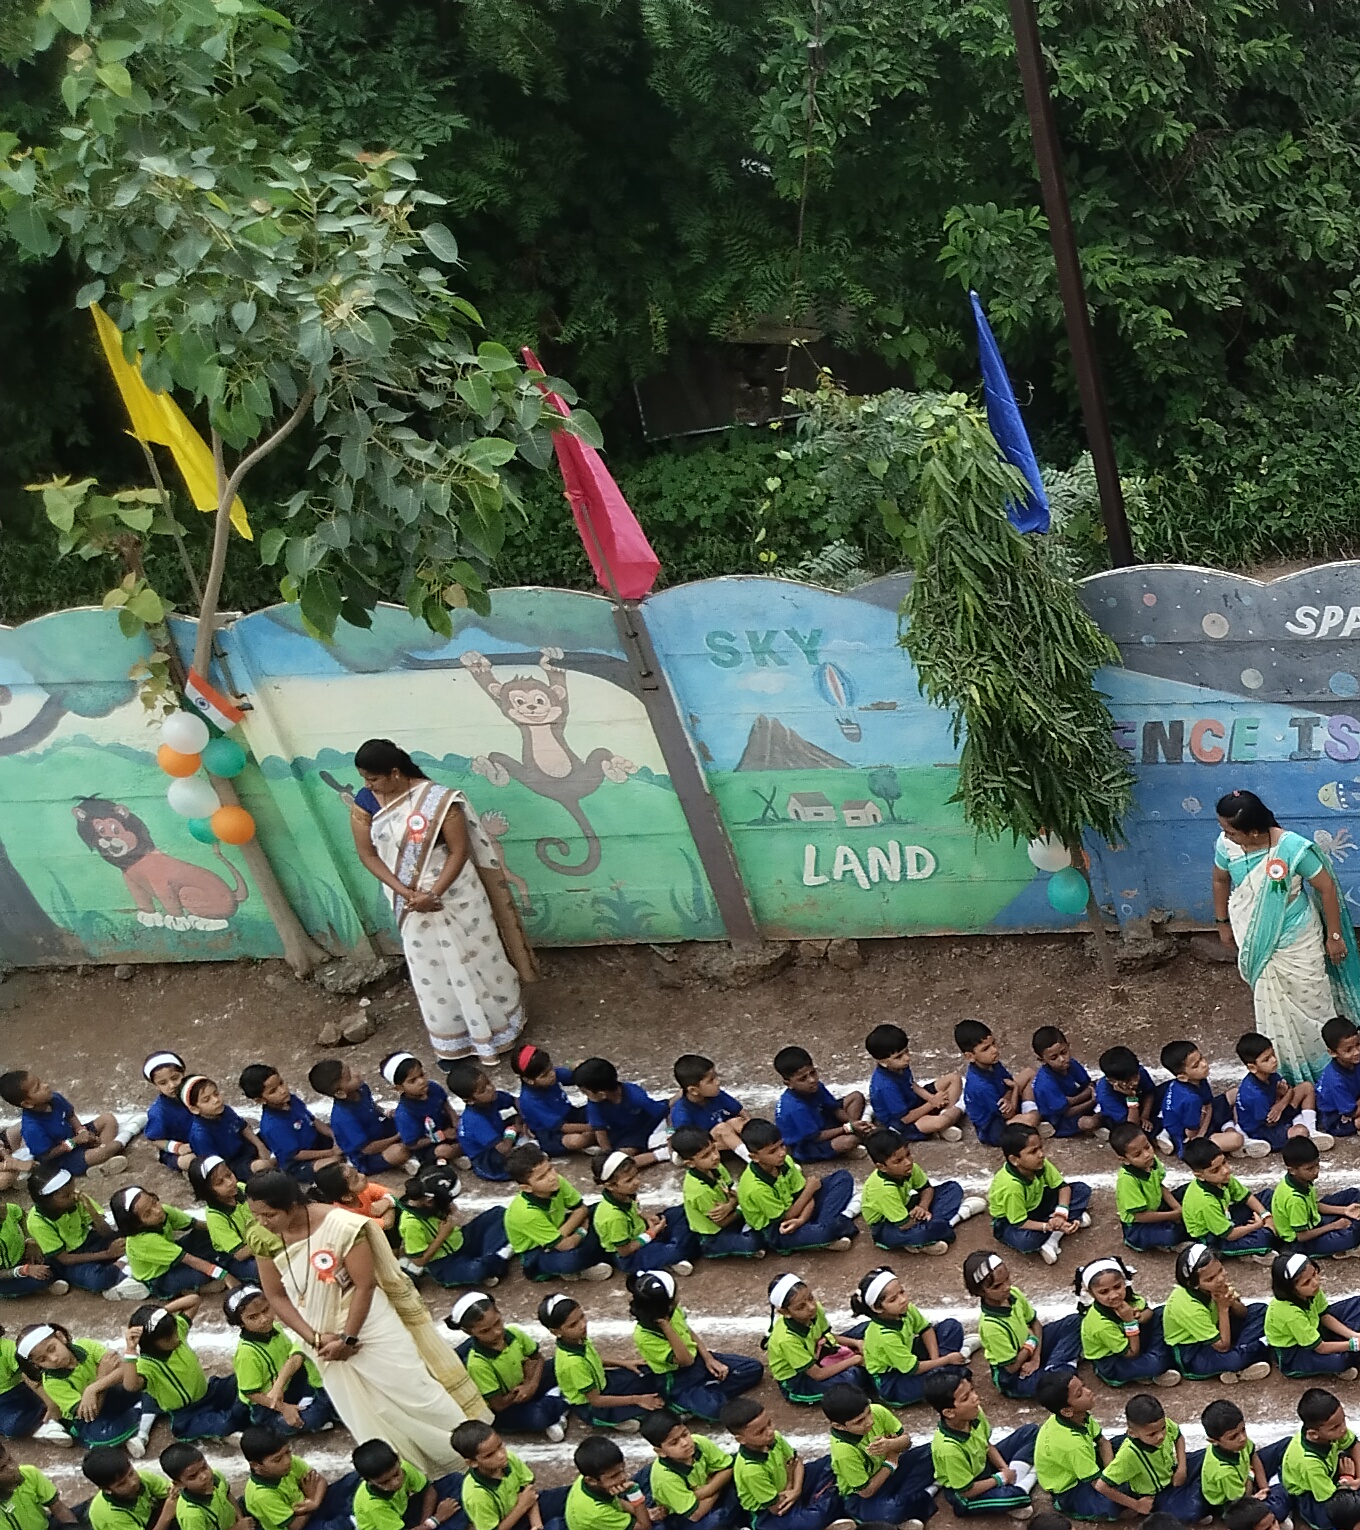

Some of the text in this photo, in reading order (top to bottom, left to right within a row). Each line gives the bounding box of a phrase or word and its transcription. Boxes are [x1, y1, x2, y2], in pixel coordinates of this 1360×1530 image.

[704, 628, 823, 669] SKY
[1112, 714, 1360, 764] ENCE IS
[802, 841, 939, 889] LAND
